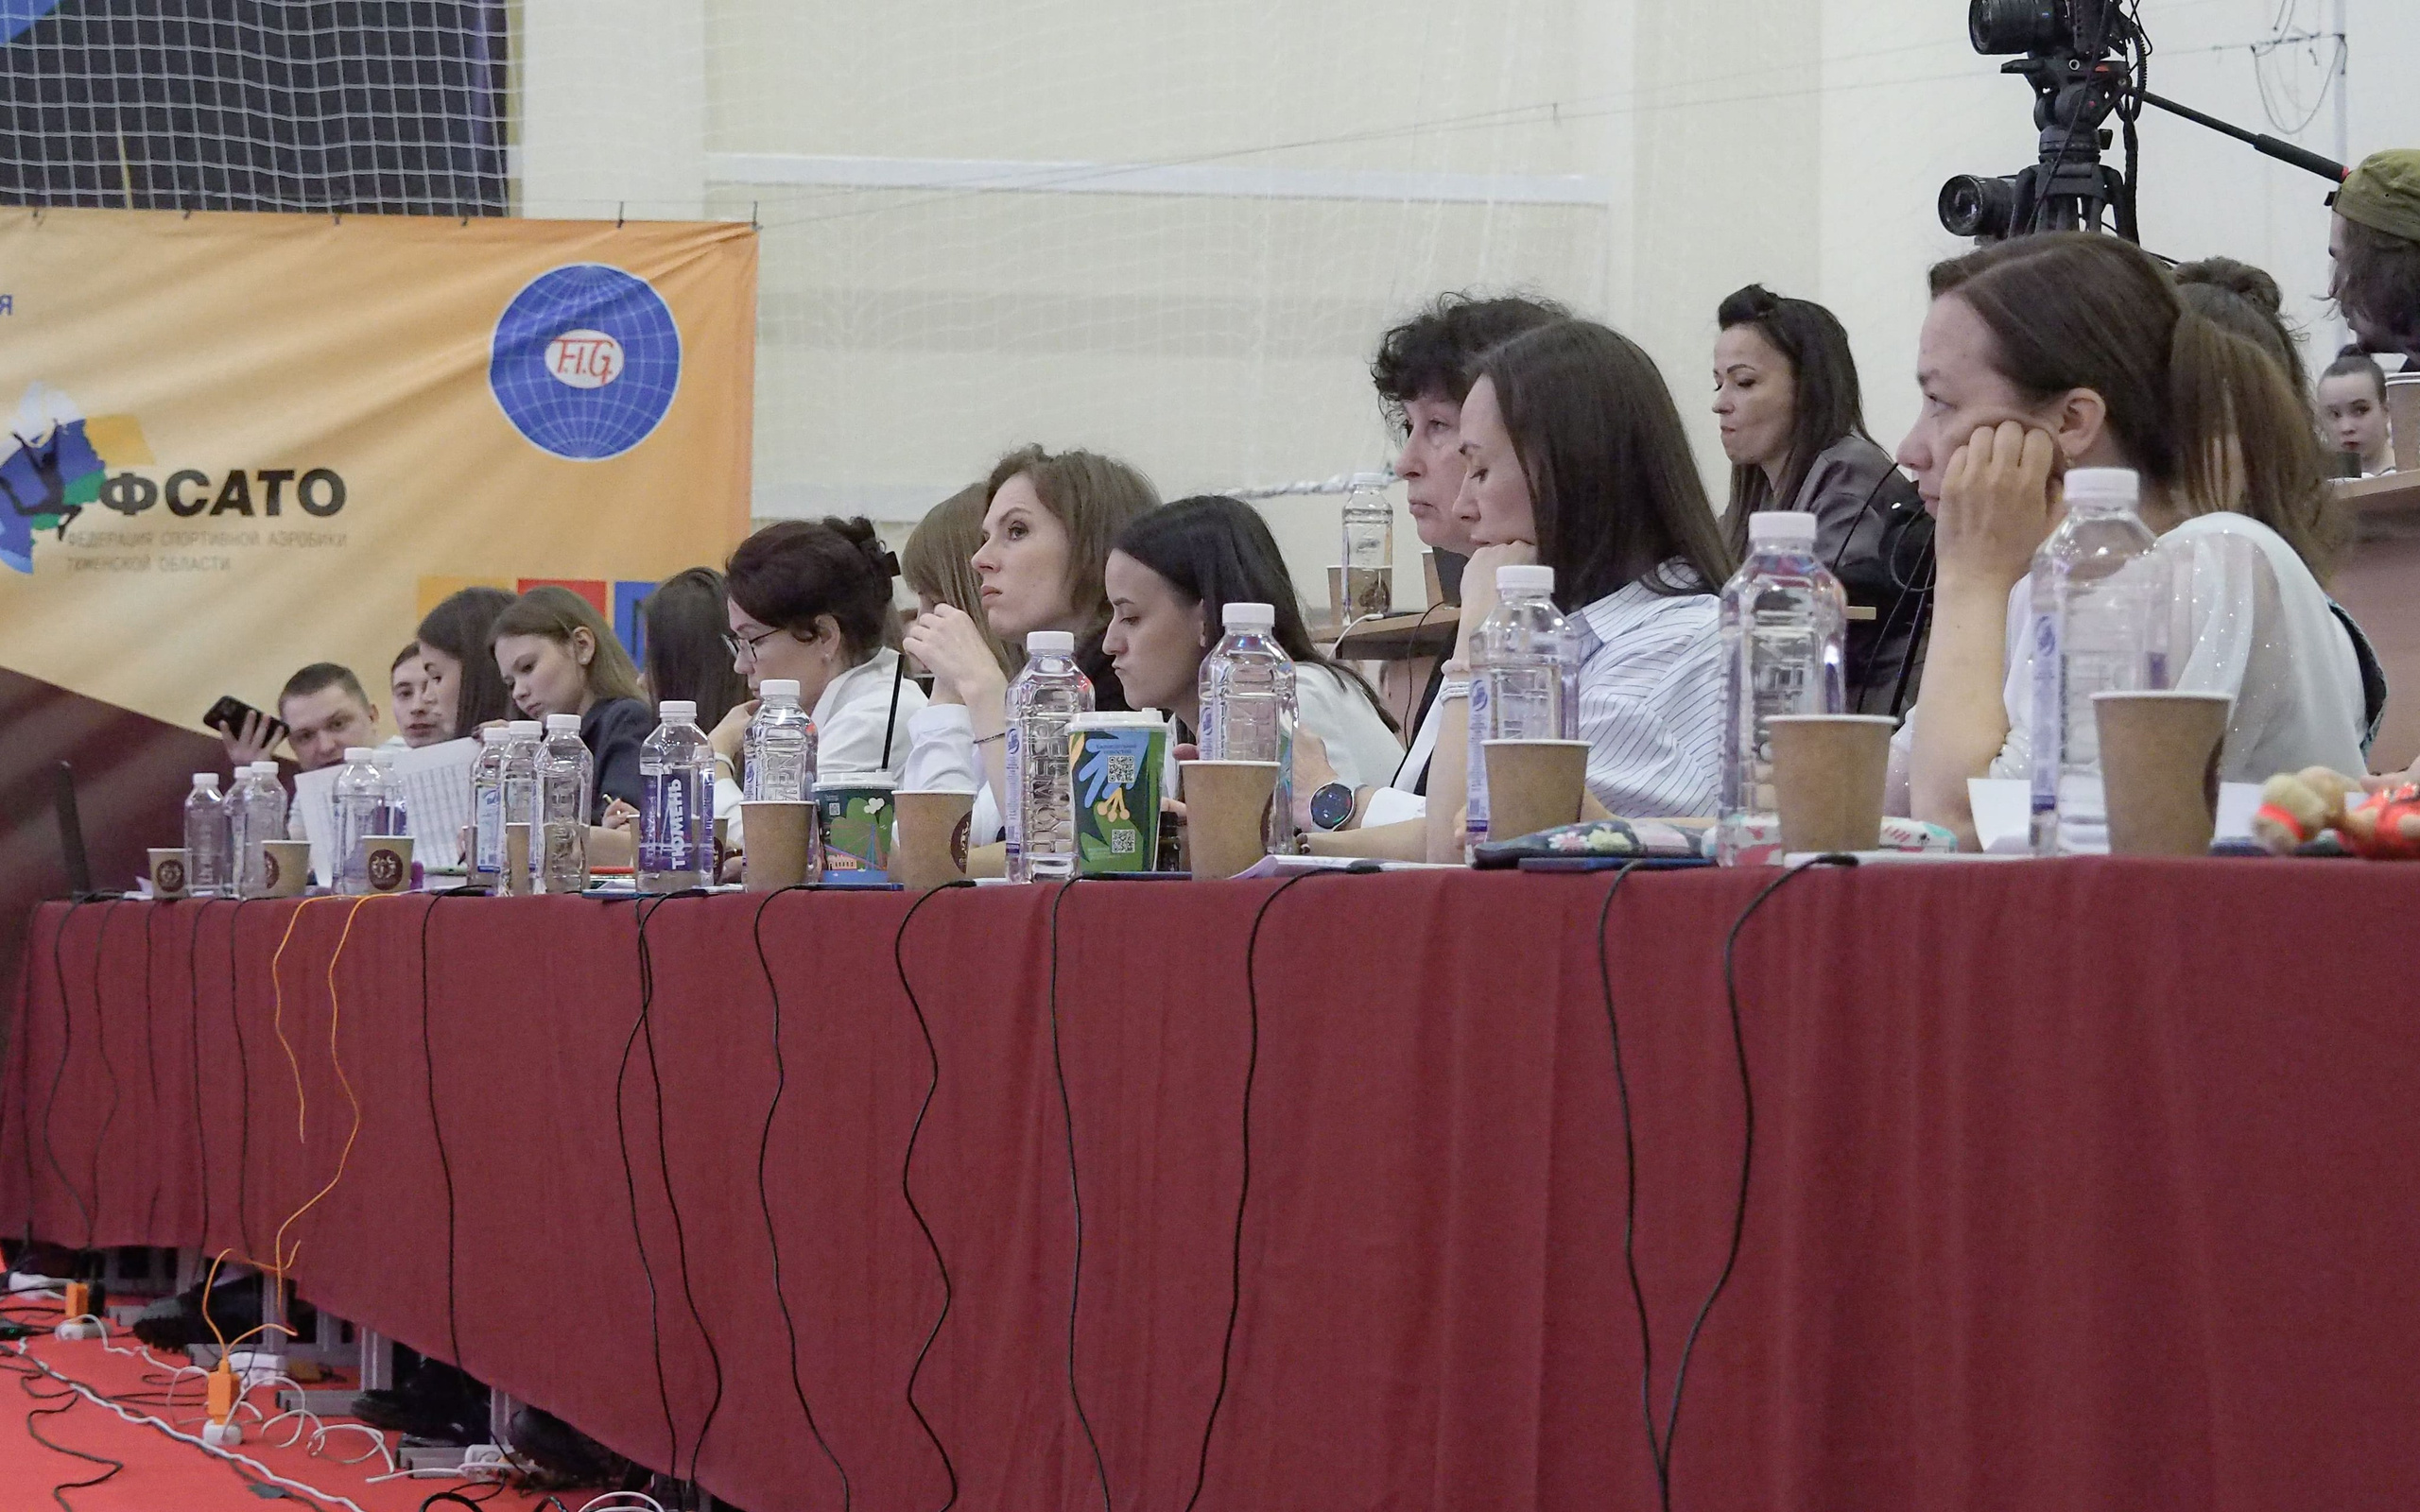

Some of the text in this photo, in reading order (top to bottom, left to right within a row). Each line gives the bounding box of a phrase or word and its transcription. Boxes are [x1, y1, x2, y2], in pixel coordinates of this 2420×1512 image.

[99, 469, 347, 518] ФСАТО
[68, 530, 347, 548] ФЕДЕРАЦИЯ СПОРТИВНОЙ АЭРОБИКИ
[159, 556, 231, 572] ОБЛАСТИ
[667, 779, 686, 870] ТЮМЕНЬ
